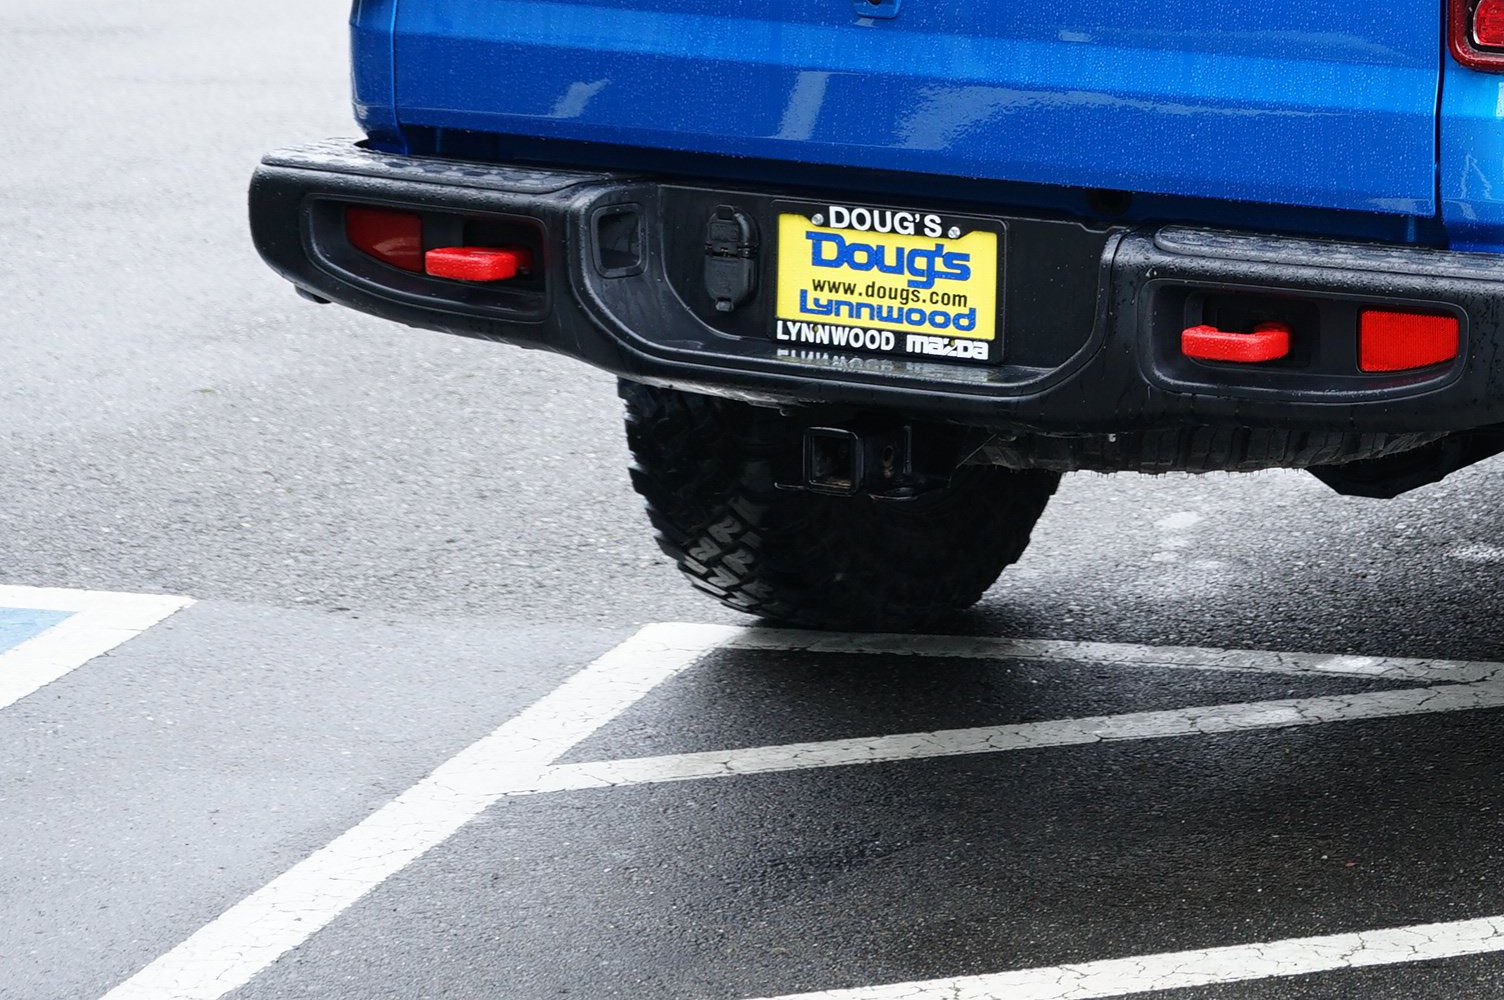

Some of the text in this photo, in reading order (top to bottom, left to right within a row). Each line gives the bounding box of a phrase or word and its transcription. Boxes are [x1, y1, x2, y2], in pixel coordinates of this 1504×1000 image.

[829, 206, 942, 237] DOUG'S
[812, 279, 968, 307] www.dougs.com
[800, 289, 976, 331] Lynnwood
[776, 320, 895, 351] LYNNWOOD
